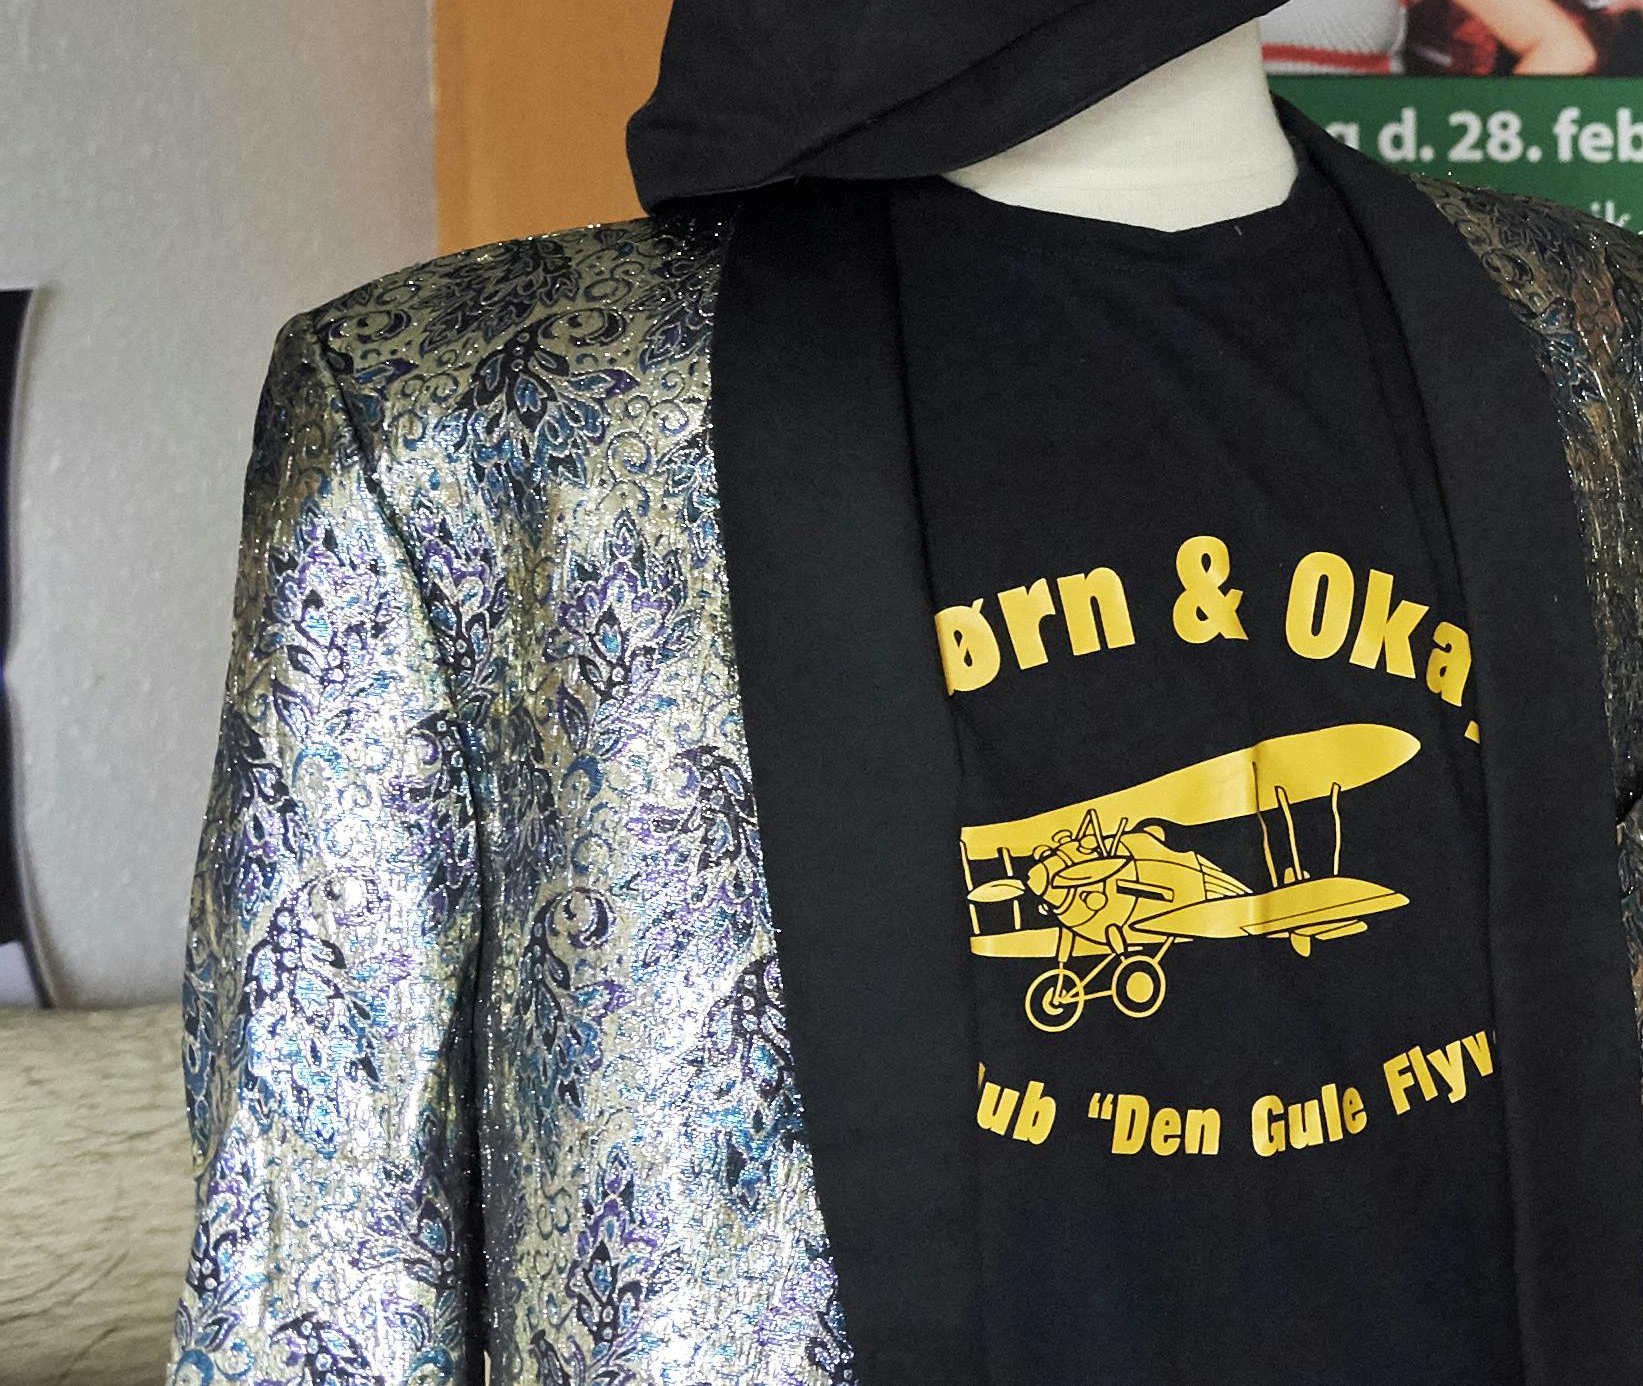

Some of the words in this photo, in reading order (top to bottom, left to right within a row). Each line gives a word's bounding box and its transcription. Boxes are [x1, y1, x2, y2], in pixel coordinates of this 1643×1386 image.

[1376, 106, 1435, 163] d.
[1447, 110, 1543, 163] 28.
[1171, 535, 1249, 644] &
[1283, 550, 1480, 744] Oka
[976, 1061, 1058, 1146] ub
[1250, 1082, 1369, 1158] Gule
[1382, 1028, 1497, 1116] Flyv
